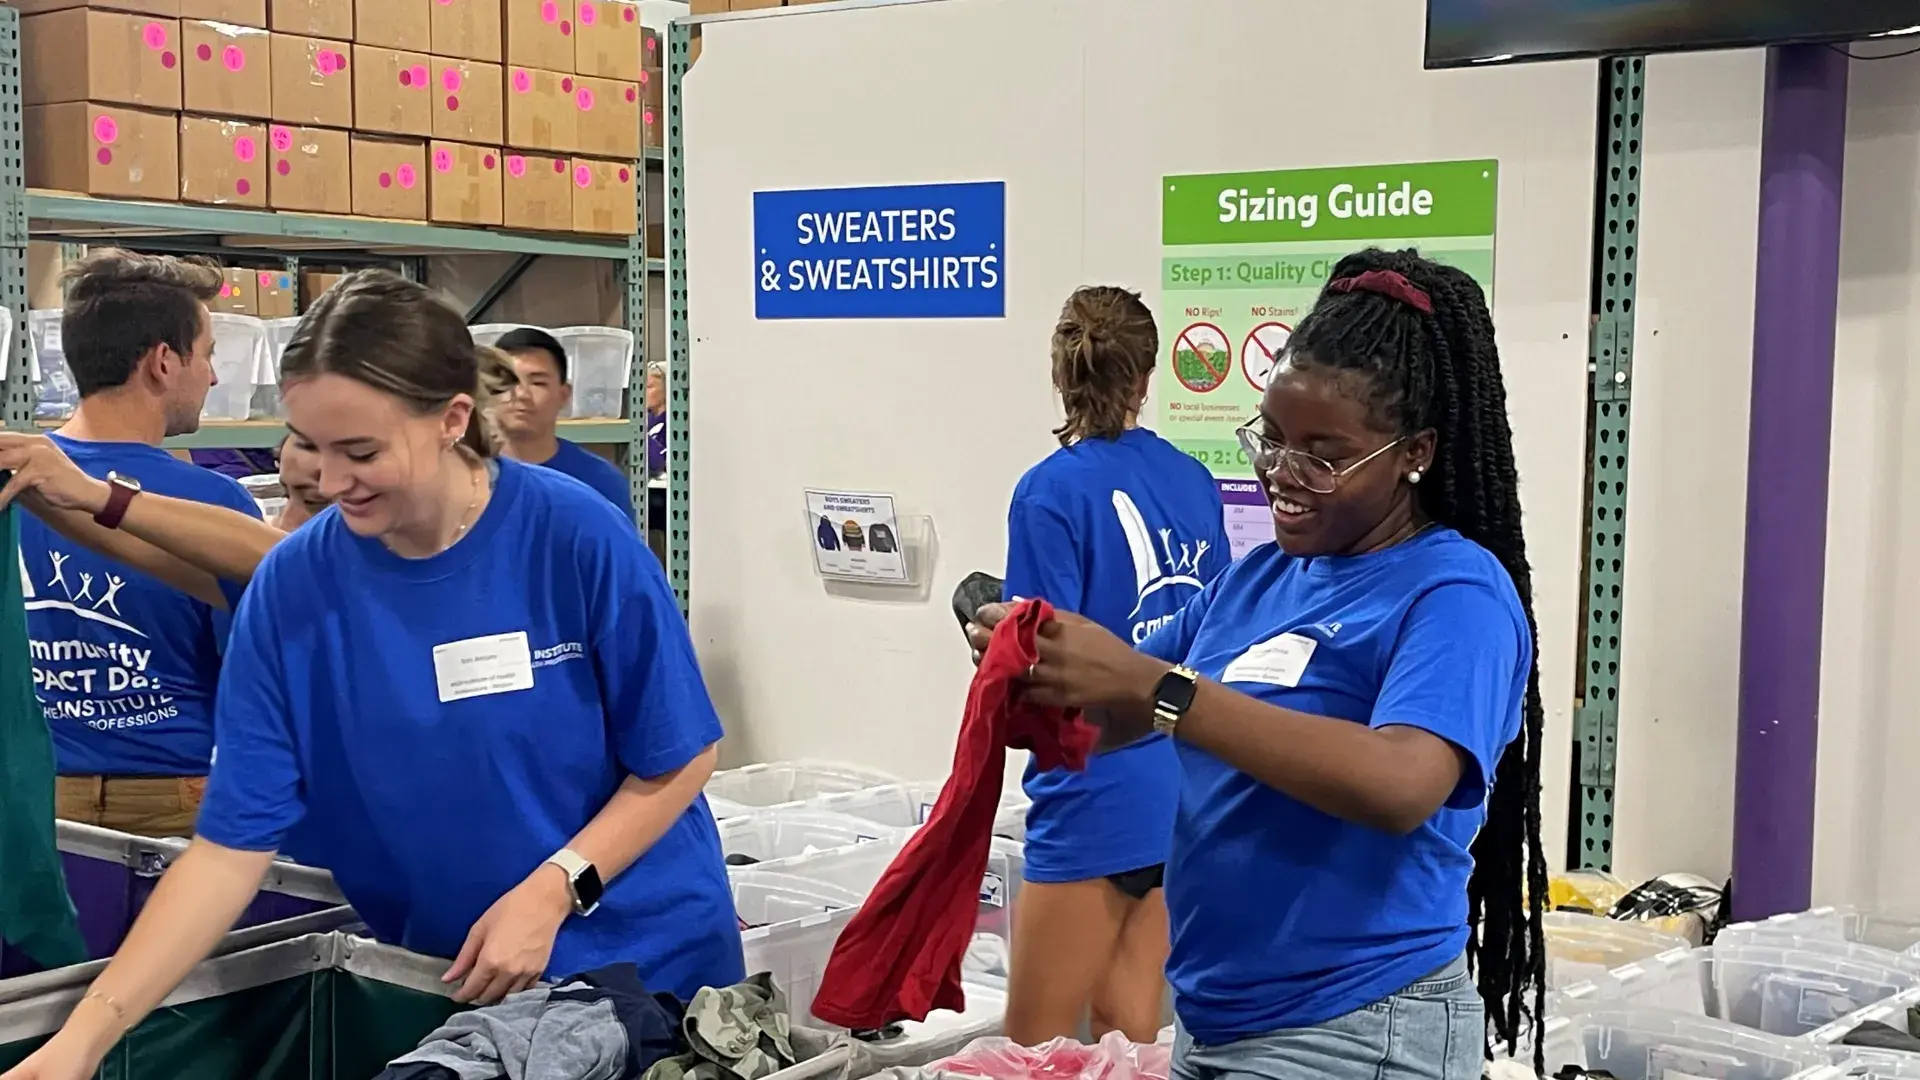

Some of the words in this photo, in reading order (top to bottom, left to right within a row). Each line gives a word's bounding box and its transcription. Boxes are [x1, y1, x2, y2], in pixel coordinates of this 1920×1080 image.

[1218, 187, 1319, 228] Sizing
[1328, 181, 1434, 218] Guide
[797, 208, 956, 245] SWEATERS
[761, 259, 782, 292] &
[788, 255, 998, 291] SWEATSHIRTS
[1171, 263, 1212, 286] Step
[1216, 266, 1231, 281] 1:
[1237, 261, 1306, 283] Quality
[1185, 307, 1199, 317] NO
[1202, 307, 1223, 318] Rips!
[1251, 306, 1266, 317] NO
[1169, 402, 1182, 410] NO
[1221, 483, 1257, 493] INCLUDES
[840, 497, 871, 505] SWEATERS
[836, 505, 876, 514] SWEATSHIRTS
[534, 642, 583, 660] INSTITUTE
